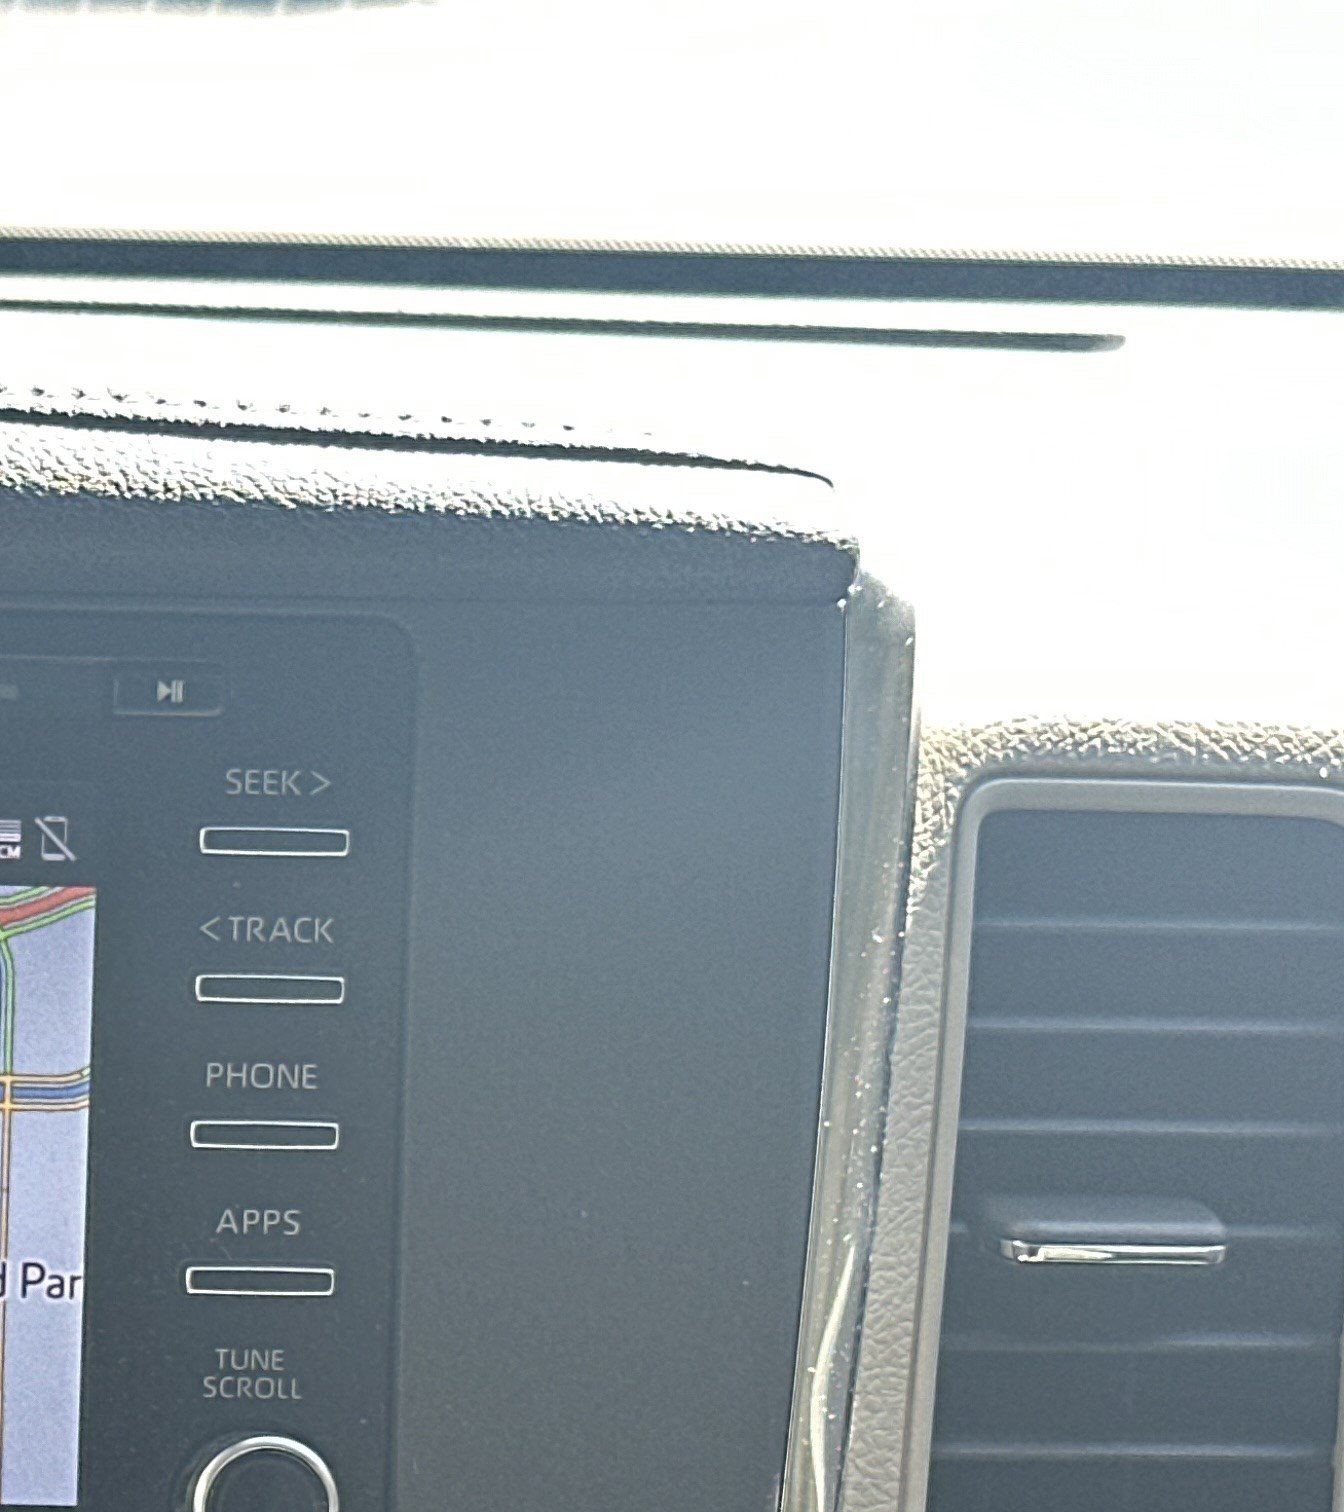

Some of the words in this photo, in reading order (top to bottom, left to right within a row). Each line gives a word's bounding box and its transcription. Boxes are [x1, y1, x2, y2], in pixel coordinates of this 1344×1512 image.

[224, 768, 303, 796] SEEK
[227, 916, 335, 944] TRACK
[205, 1062, 319, 1090] PHONE
[215, 1208, 302, 1236] APPS
[213, 1348, 285, 1371] TUNE
[202, 1376, 303, 1400] SCROLL
